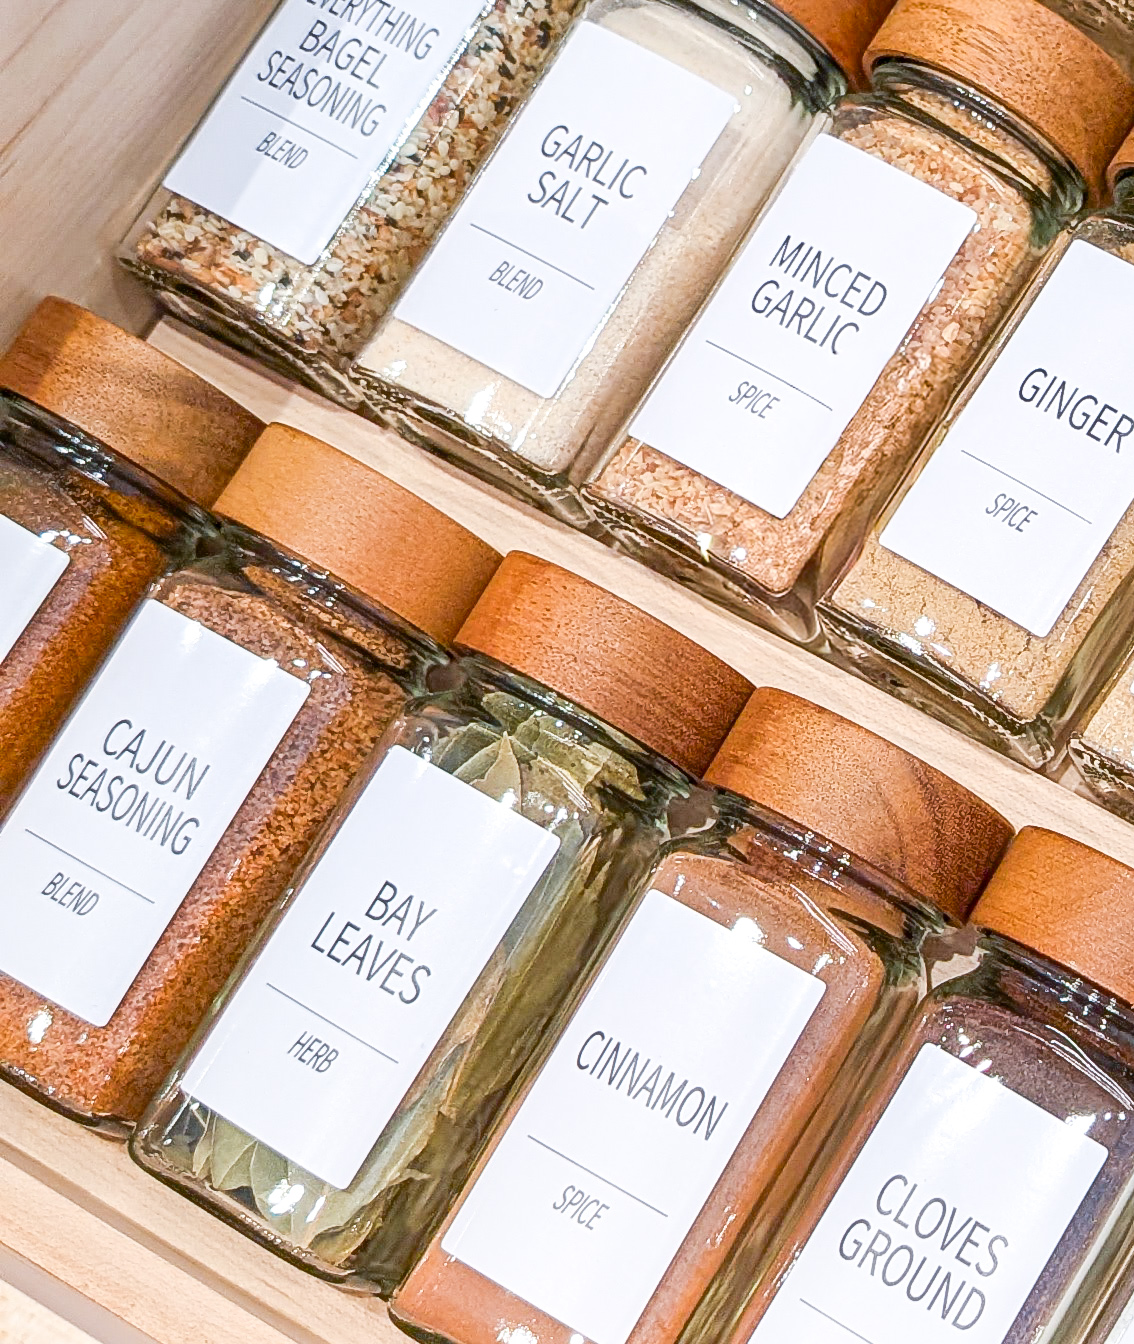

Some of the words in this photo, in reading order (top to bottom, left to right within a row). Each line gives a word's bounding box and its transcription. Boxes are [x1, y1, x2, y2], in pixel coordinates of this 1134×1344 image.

[300, 20, 387, 88] BAGEL
[257, 51, 387, 137] SEASONING
[256, 132, 308, 169] BLEND
[541, 126, 647, 199] GARLIC
[528, 172, 608, 229] SALT
[489, 261, 542, 299] BLEND
[769, 235, 887, 316] MINCED
[751, 279, 859, 355] GARLIC
[729, 381, 780, 419] SPICE
[1018, 368, 1134, 452] GINGER
[986, 493, 1038, 533] SPICE
[103, 719, 210, 800] CAJUN
[57, 754, 200, 855] SEASONING
[41, 872, 100, 916] BLEND
[366, 880, 437, 942] BAY
[311, 913, 431, 1005] LEAVES
[287, 1030, 339, 1073] HERB
[576, 1031, 728, 1141] CINNAMON
[552, 1185, 610, 1230] SPICE
[876, 1174, 1008, 1277] CLOVES
[839, 1218, 985, 1331] GROUND
